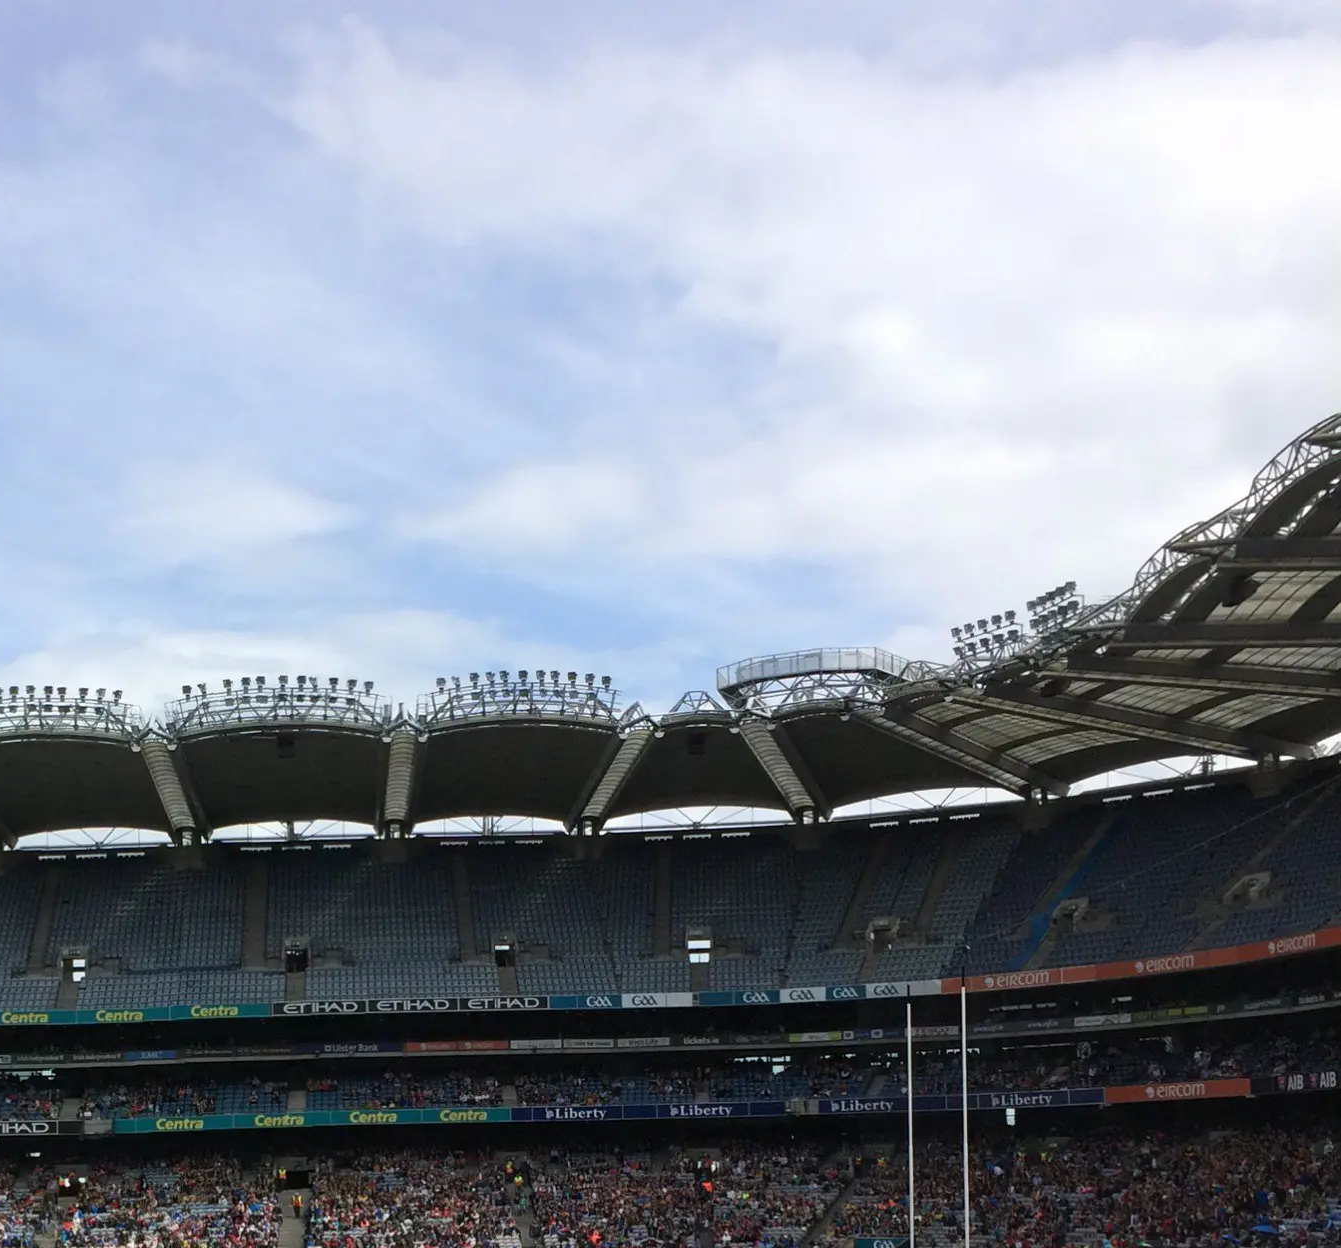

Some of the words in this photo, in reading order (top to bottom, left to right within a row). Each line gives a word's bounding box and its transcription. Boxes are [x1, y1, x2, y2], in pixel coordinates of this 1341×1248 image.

[283, 1001, 358, 1014] ETIHAD
[376, 999, 450, 1010] ETIHAD
[467, 997, 540, 1009] ETIHAD
[96, 1010, 143, 1021] Centra
[191, 1004, 238, 1017] Centra
[1, 1012, 49, 1023] Centra
[332, 1044, 357, 1052] Ulster
[358, 1043, 379, 1052] Bank
[1287, 1074, 1304, 1090] AIB
[1319, 1071, 1337, 1088] AIB
[841, 1100, 894, 1112] Liberty
[1002, 1094, 1052, 1106] Liberty
[439, 1109, 488, 1121] Centra
[556, 1108, 607, 1120] Liberty
[680, 1104, 733, 1117] Liberty
[254, 1114, 304, 1127] Centra
[349, 1111, 398, 1123] Centra
[155, 1118, 204, 1130] Centra
